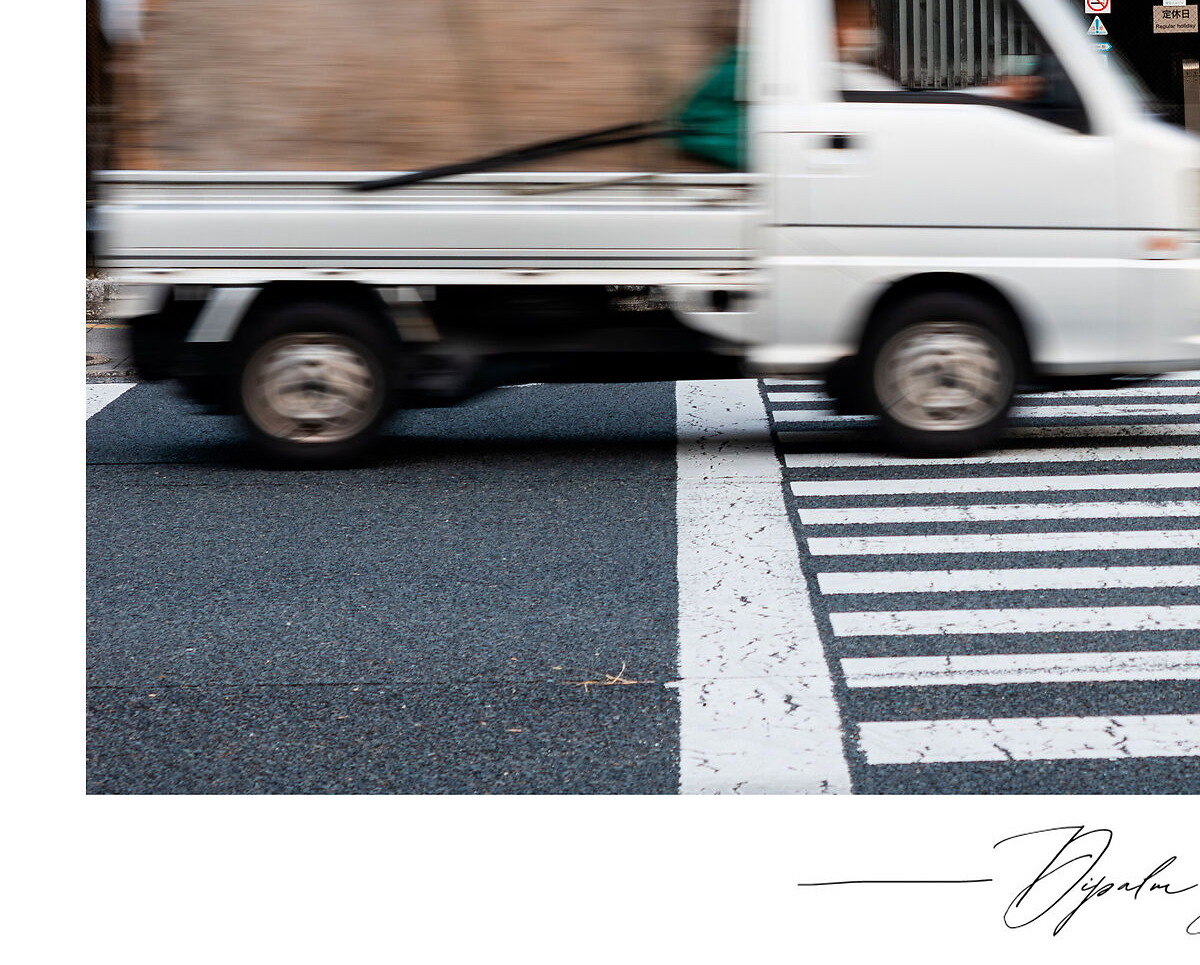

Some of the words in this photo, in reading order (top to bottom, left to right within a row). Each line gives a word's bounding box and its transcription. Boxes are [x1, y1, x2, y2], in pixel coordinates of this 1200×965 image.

[1162, 9, 1190, 19] 定休日
[1176, 22, 1197, 30] holiday
